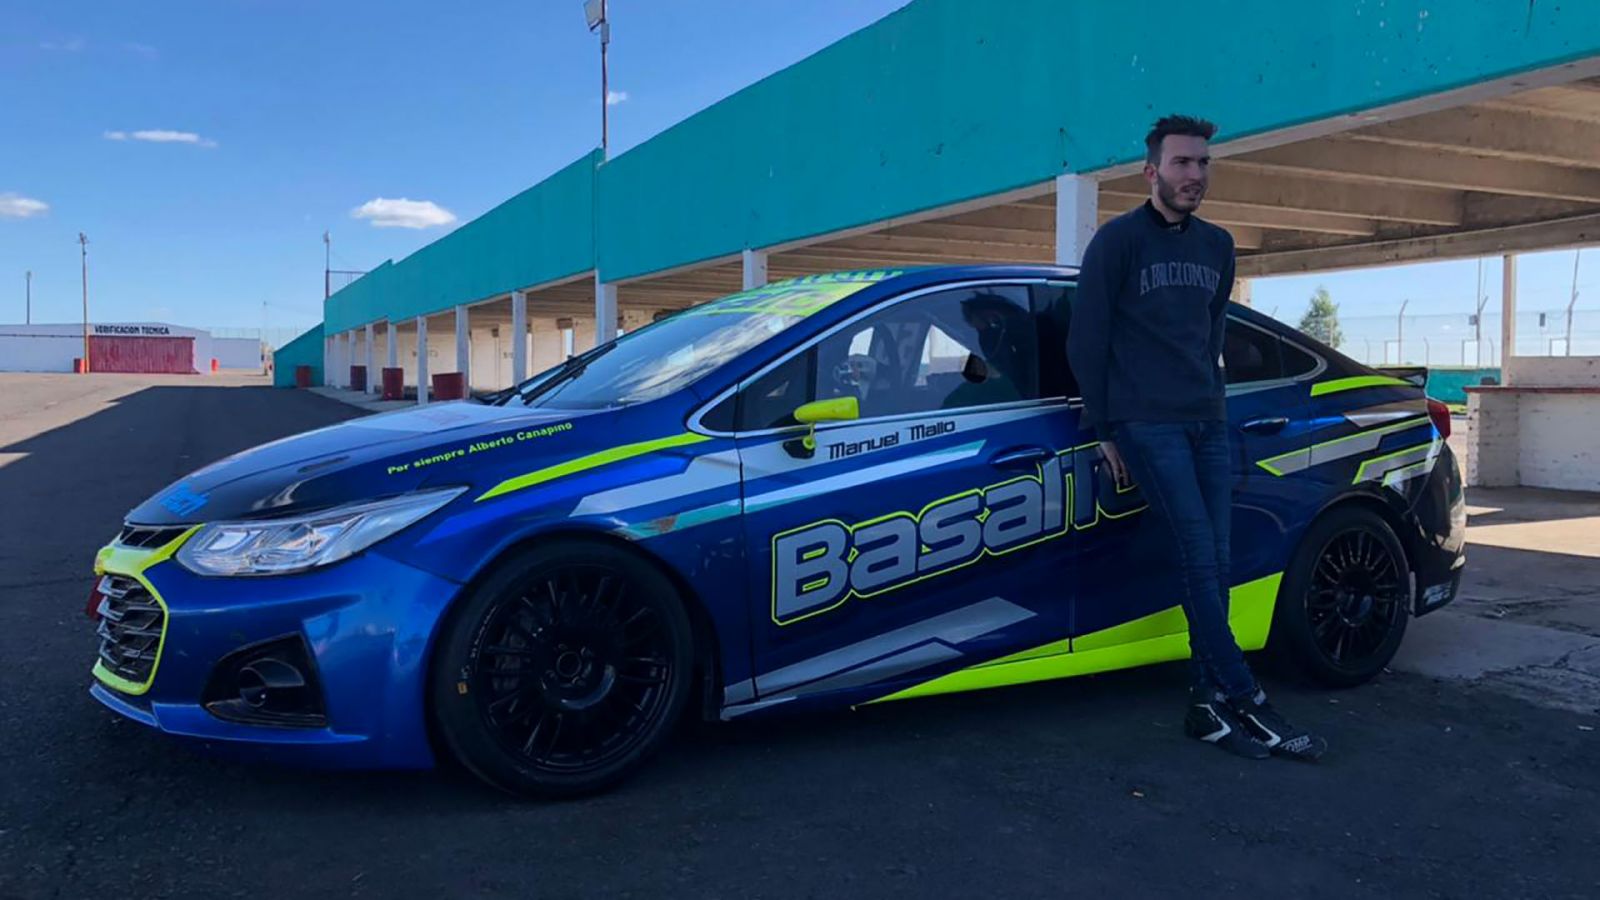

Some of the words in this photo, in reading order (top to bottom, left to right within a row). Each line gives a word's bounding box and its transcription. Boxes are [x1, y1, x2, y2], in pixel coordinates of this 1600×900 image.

[94, 325, 140, 334] VERIFICACION
[387, 463, 410, 474] Por
[413, 447, 465, 468] siempre
[469, 435, 514, 454] Alberto
[517, 421, 573, 441] Canapino
[825, 431, 899, 460] Manuel
[907, 421, 956, 441] Mallo
